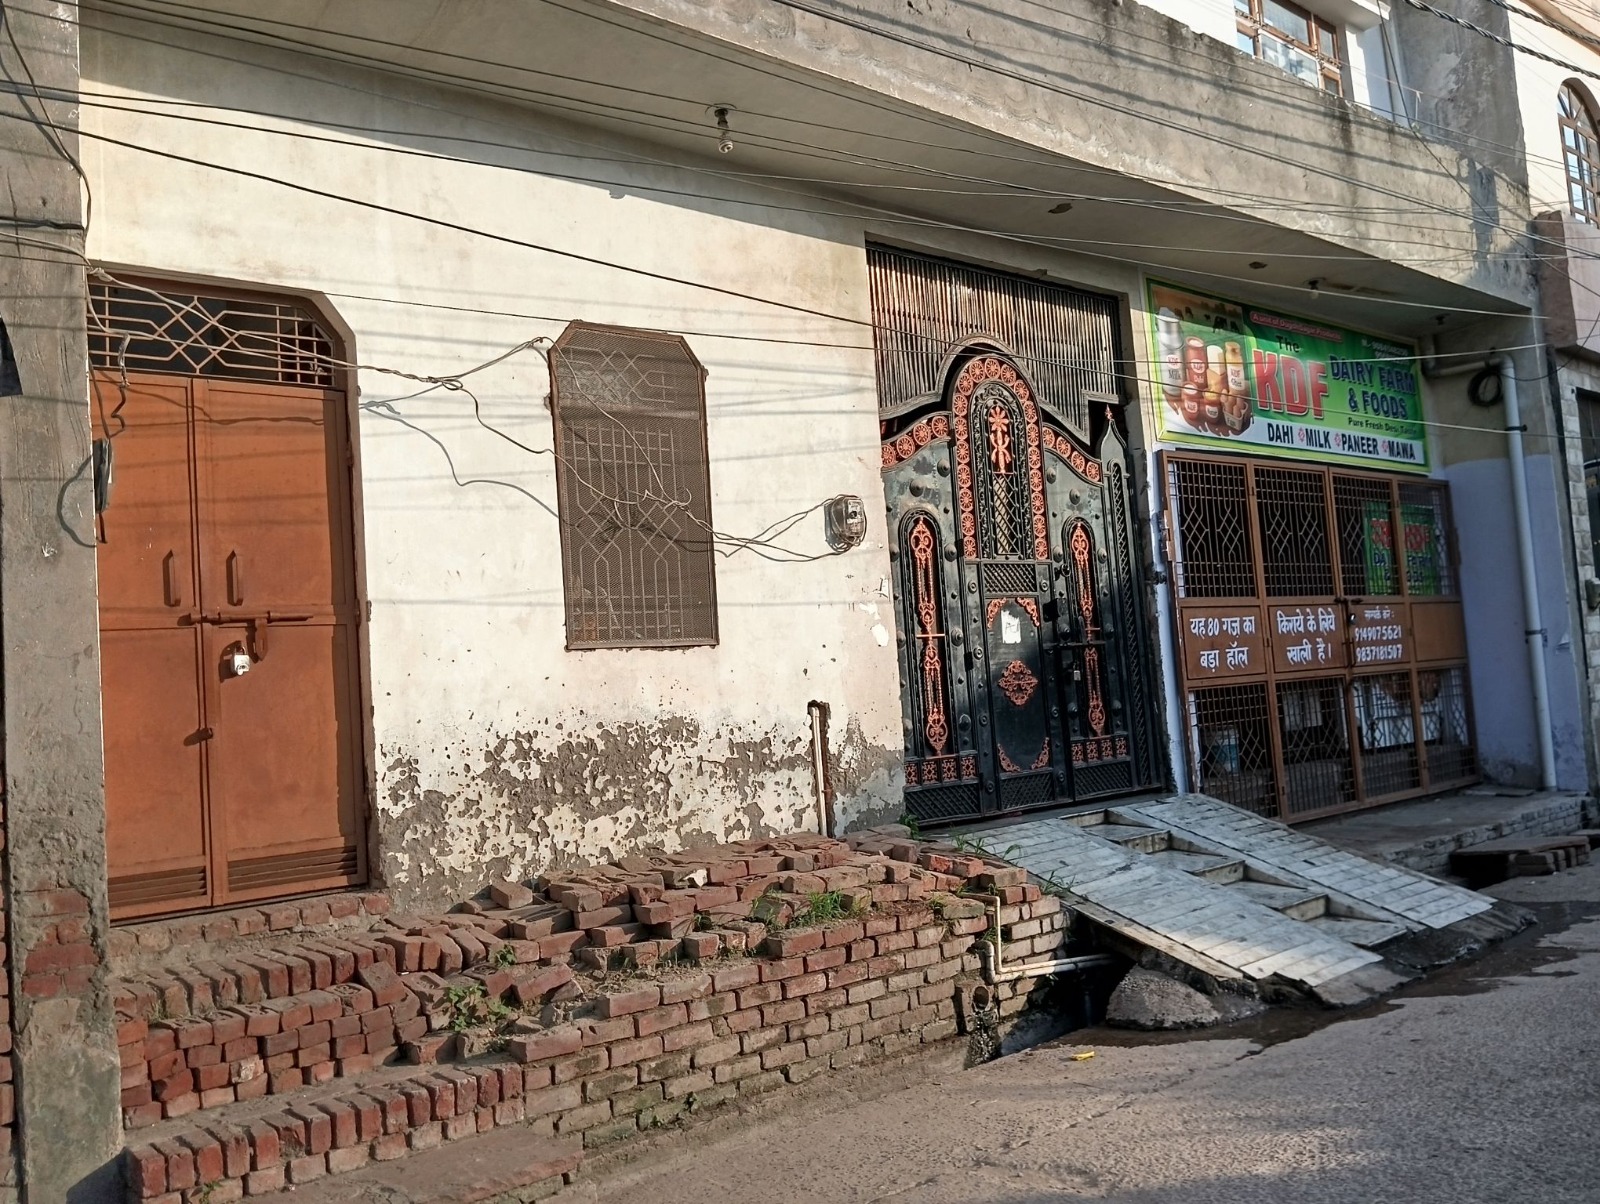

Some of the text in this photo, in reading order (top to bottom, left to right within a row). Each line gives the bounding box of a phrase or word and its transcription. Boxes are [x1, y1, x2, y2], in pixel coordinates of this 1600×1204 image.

[1275, 335, 1300, 352] The
[1252, 349, 1329, 419] KDF
[1329, 355, 1374, 387] DAIRY
[1377, 366, 1417, 394] FARM
[1348, 387, 1408, 420] & FOODS
[1267, 422, 1416, 460] DAHI MILK PANEER MAWA
[1190, 617, 1206, 639] यह
[1207, 617, 1220, 636] 80
[1242, 615, 1256, 634] का
[1276, 607, 1336, 636] किराये के लिये
[1355, 625, 1402, 642] 9149075621
[1199, 640, 1249, 673] बड़ा हॉल
[1286, 638, 1312, 665] खाली
